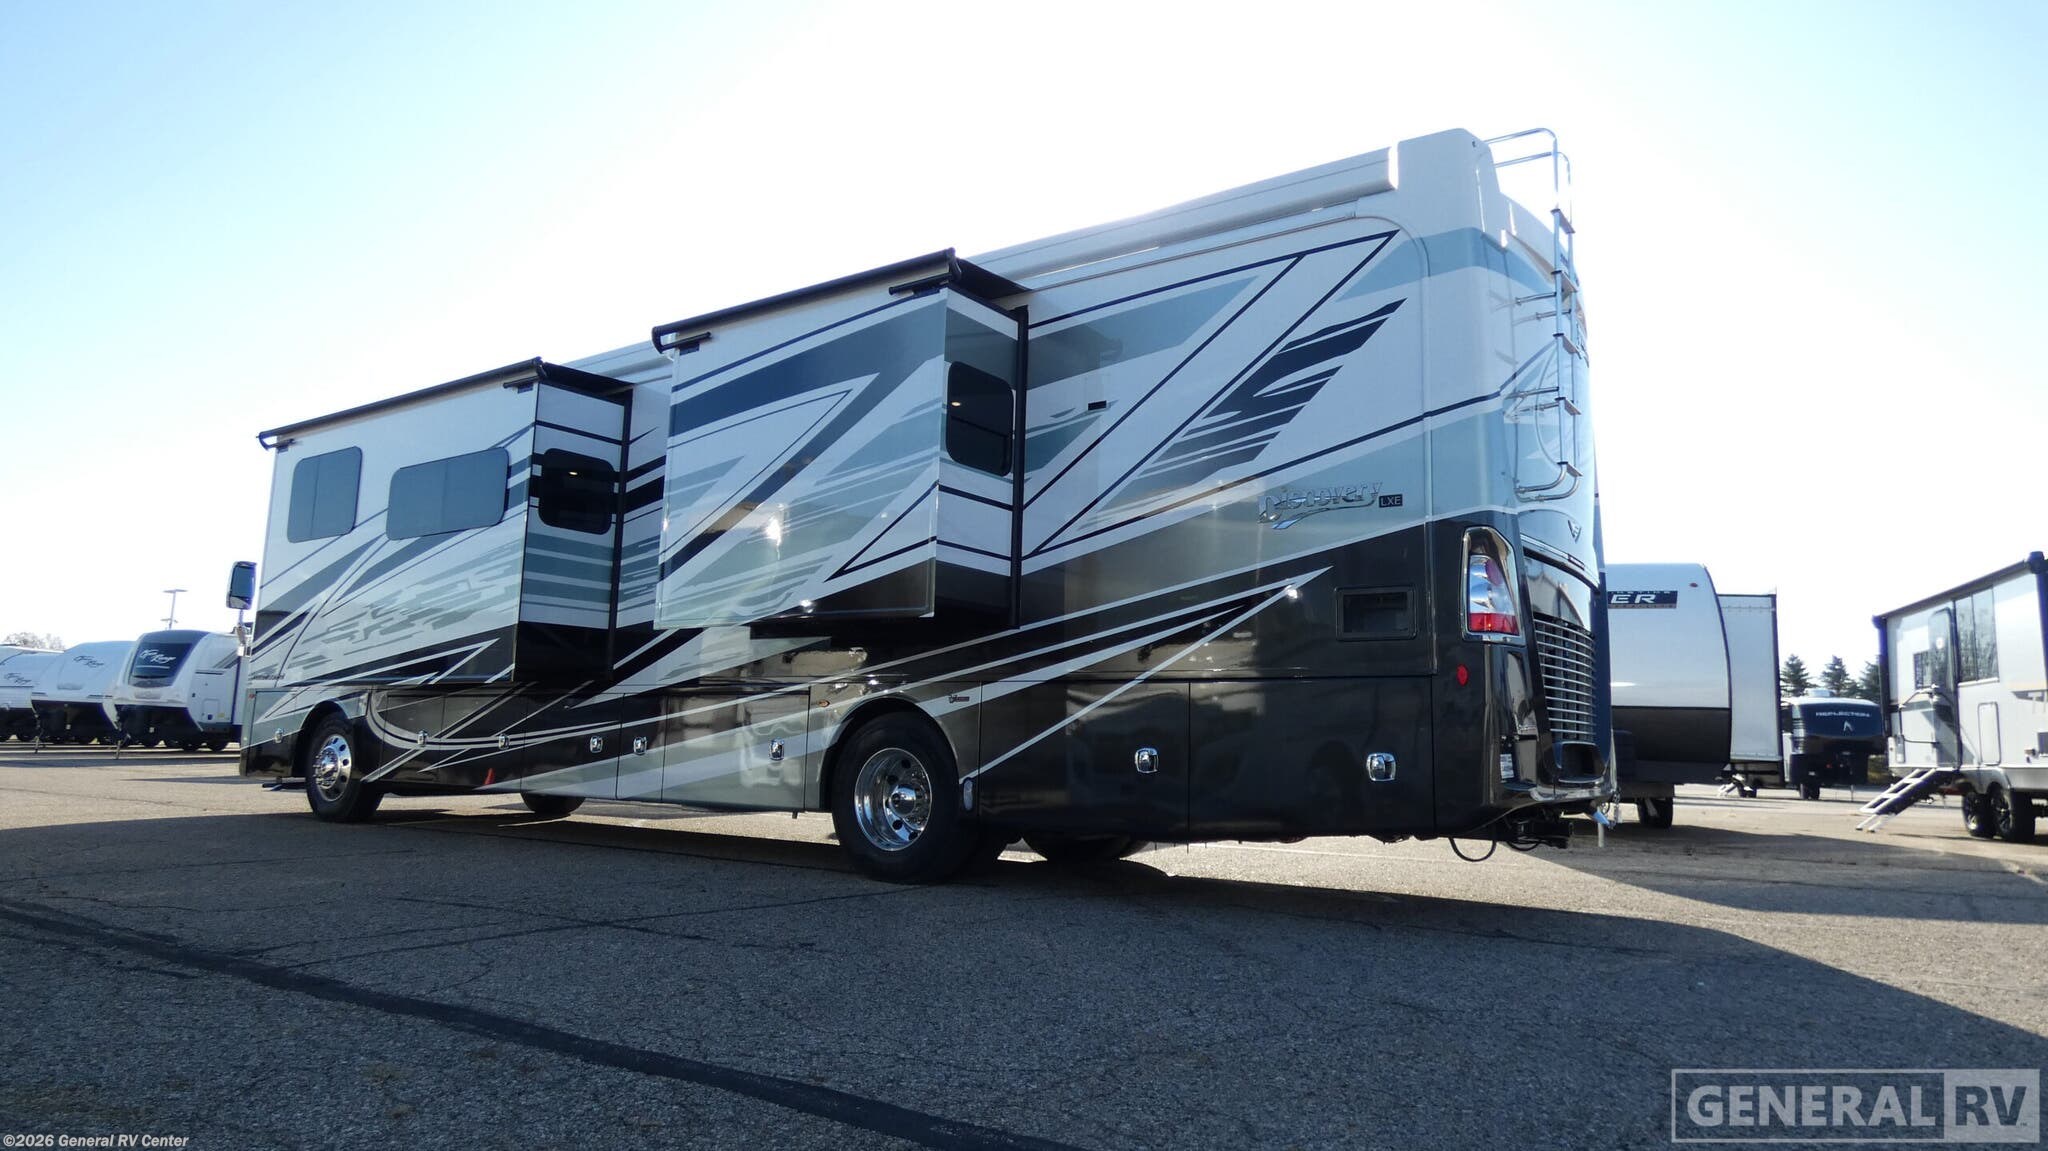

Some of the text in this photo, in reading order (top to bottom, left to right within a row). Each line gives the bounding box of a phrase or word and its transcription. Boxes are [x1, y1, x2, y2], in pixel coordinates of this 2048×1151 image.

[1258, 482, 1402, 526] Discovery LXE
[1610, 594, 1656, 604] ER
